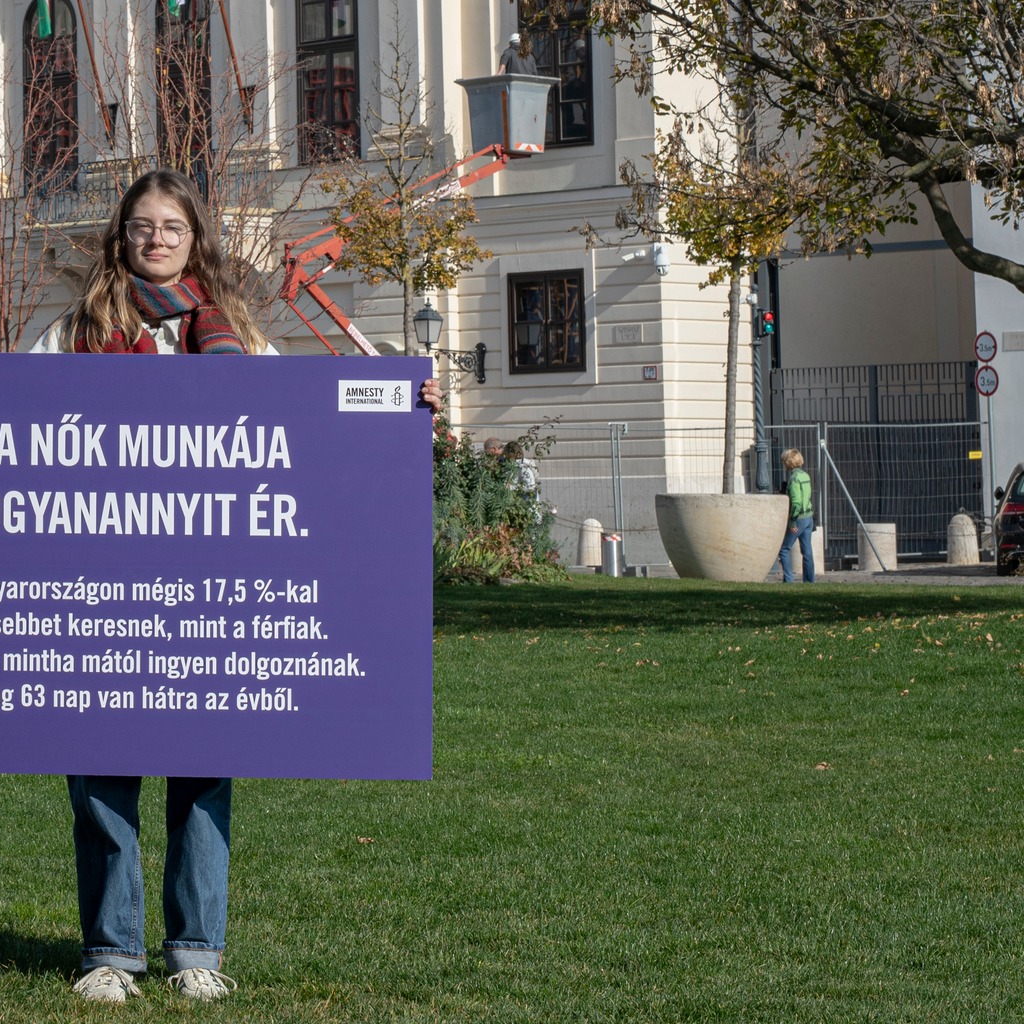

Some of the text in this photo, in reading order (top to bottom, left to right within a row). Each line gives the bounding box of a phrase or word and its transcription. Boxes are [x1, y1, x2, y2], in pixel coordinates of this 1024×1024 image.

[345, 387, 384, 397] AMNESTY
[30, 413, 108, 467] NŐK
[118, 415, 292, 469] MUNKÁJA
[249, 483, 309, 537] ÉR.
[132, 576, 195, 607] mégis
[202, 577, 247, 606] 17,5
[253, 578, 318, 604] %-kal
[68, 612, 173, 642] keresnek,
[179, 614, 227, 639] mint
[232, 620, 246, 639] a
[251, 614, 329, 640] férfiak.
[3, 647, 75, 673] mintha
[81, 648, 141, 674] mától
[148, 649, 218, 680] ingyen
[224, 651, 366, 681] dolgoznának.
[20, 683, 46, 708] 63
[53, 689, 91, 713] nap
[97, 690, 135, 709] van
[142, 685, 198, 710] hátra
[204, 691, 230, 711] az
[236, 686, 299, 712] évből.
